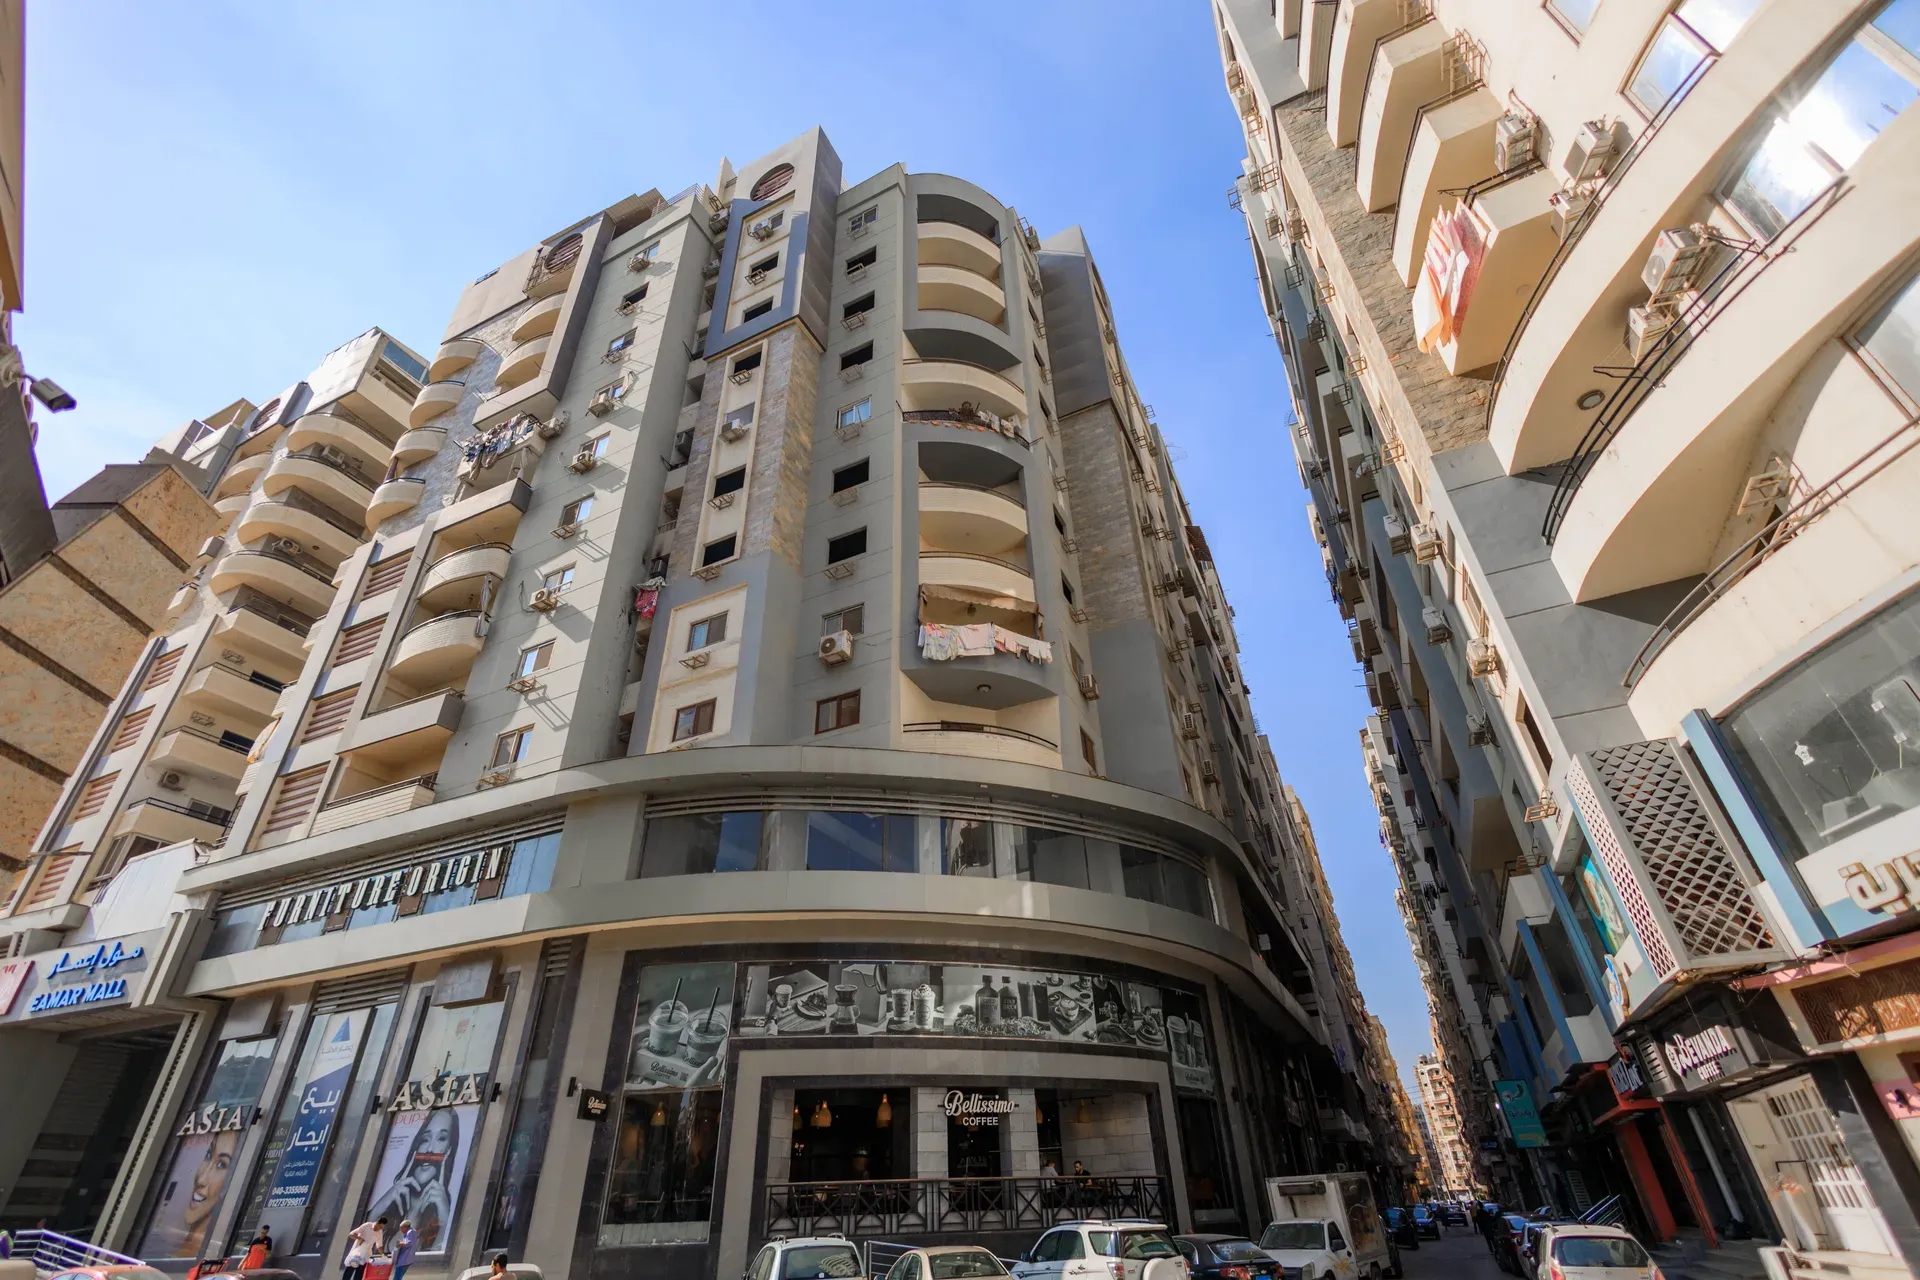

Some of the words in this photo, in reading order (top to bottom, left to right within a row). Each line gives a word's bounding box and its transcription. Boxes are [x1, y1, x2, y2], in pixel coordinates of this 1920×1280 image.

[257, 869, 404, 931] FURNITURE
[406, 848, 503, 897] ORIGIN
[46, 944, 105, 979] إعمار
[100, 942, 144, 969] مول
[29, 987, 86, 1012] EAMAR
[81, 979, 126, 1003] MALL
[301, 1087, 340, 1114] بيع
[387, 1068, 480, 1111] ASIA
[945, 1090, 1015, 1116] Bellissimo
[176, 1101, 242, 1136] ASIA
[962, 1116, 999, 1126] COFFEE
